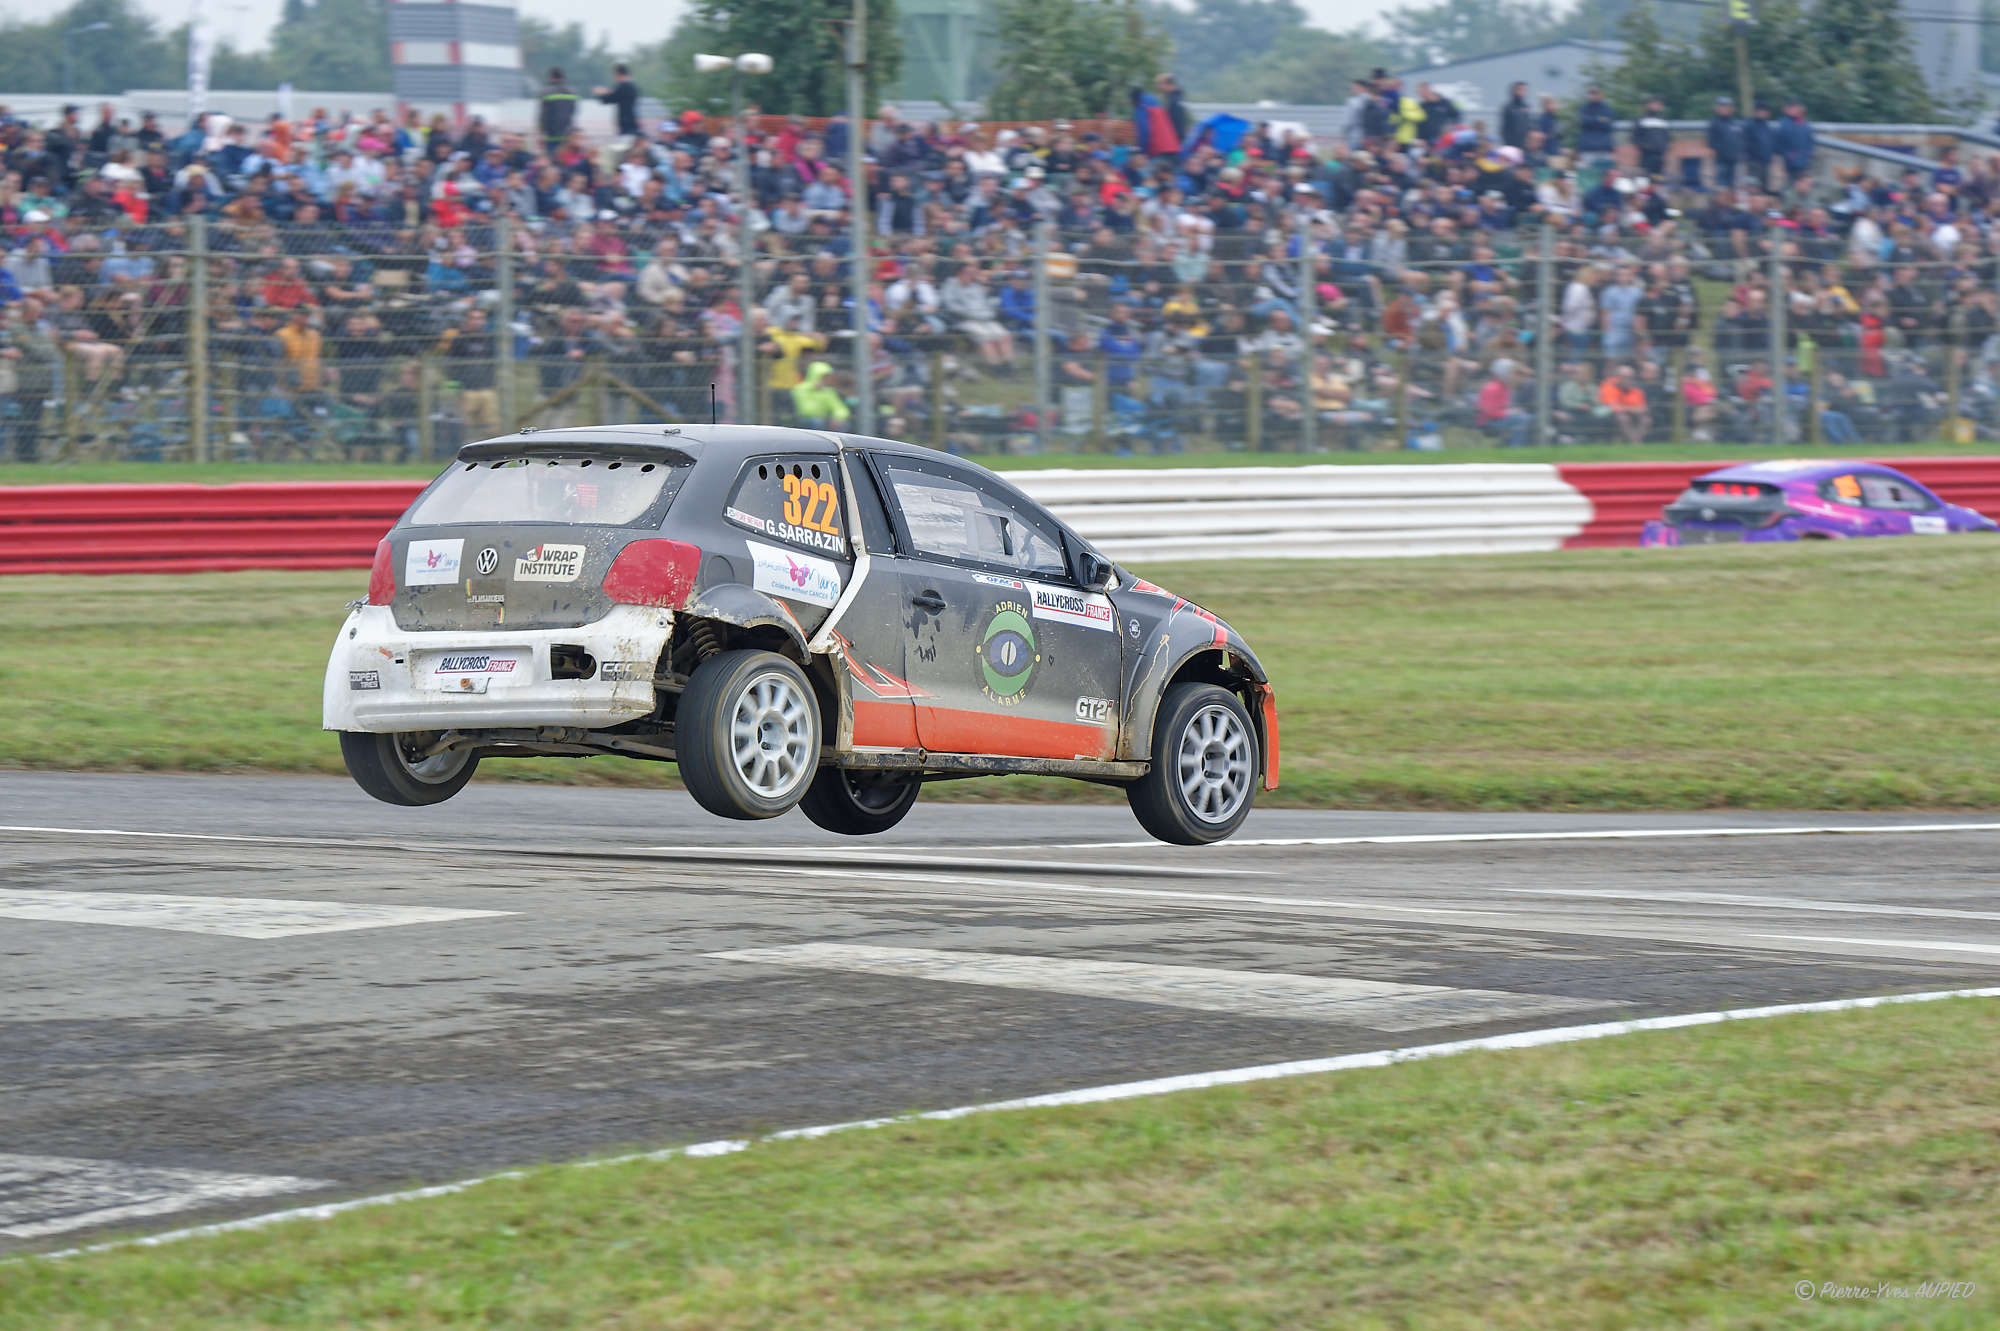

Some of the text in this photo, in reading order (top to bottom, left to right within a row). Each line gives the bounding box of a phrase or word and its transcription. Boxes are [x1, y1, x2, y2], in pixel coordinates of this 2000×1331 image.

[783, 473, 839, 536] 322
[766, 519, 845, 554] G.SARRAZIN
[542, 549, 578, 562] WRAP
[519, 562, 576, 576] INSTITUTE
[995, 600, 1028, 619] ADRIEN
[1036, 590, 1110, 621] RALLYCROSS FRANCE
[438, 656, 515, 672] RALLYCROSS FRANCE
[983, 685, 1026, 705] ALARME
